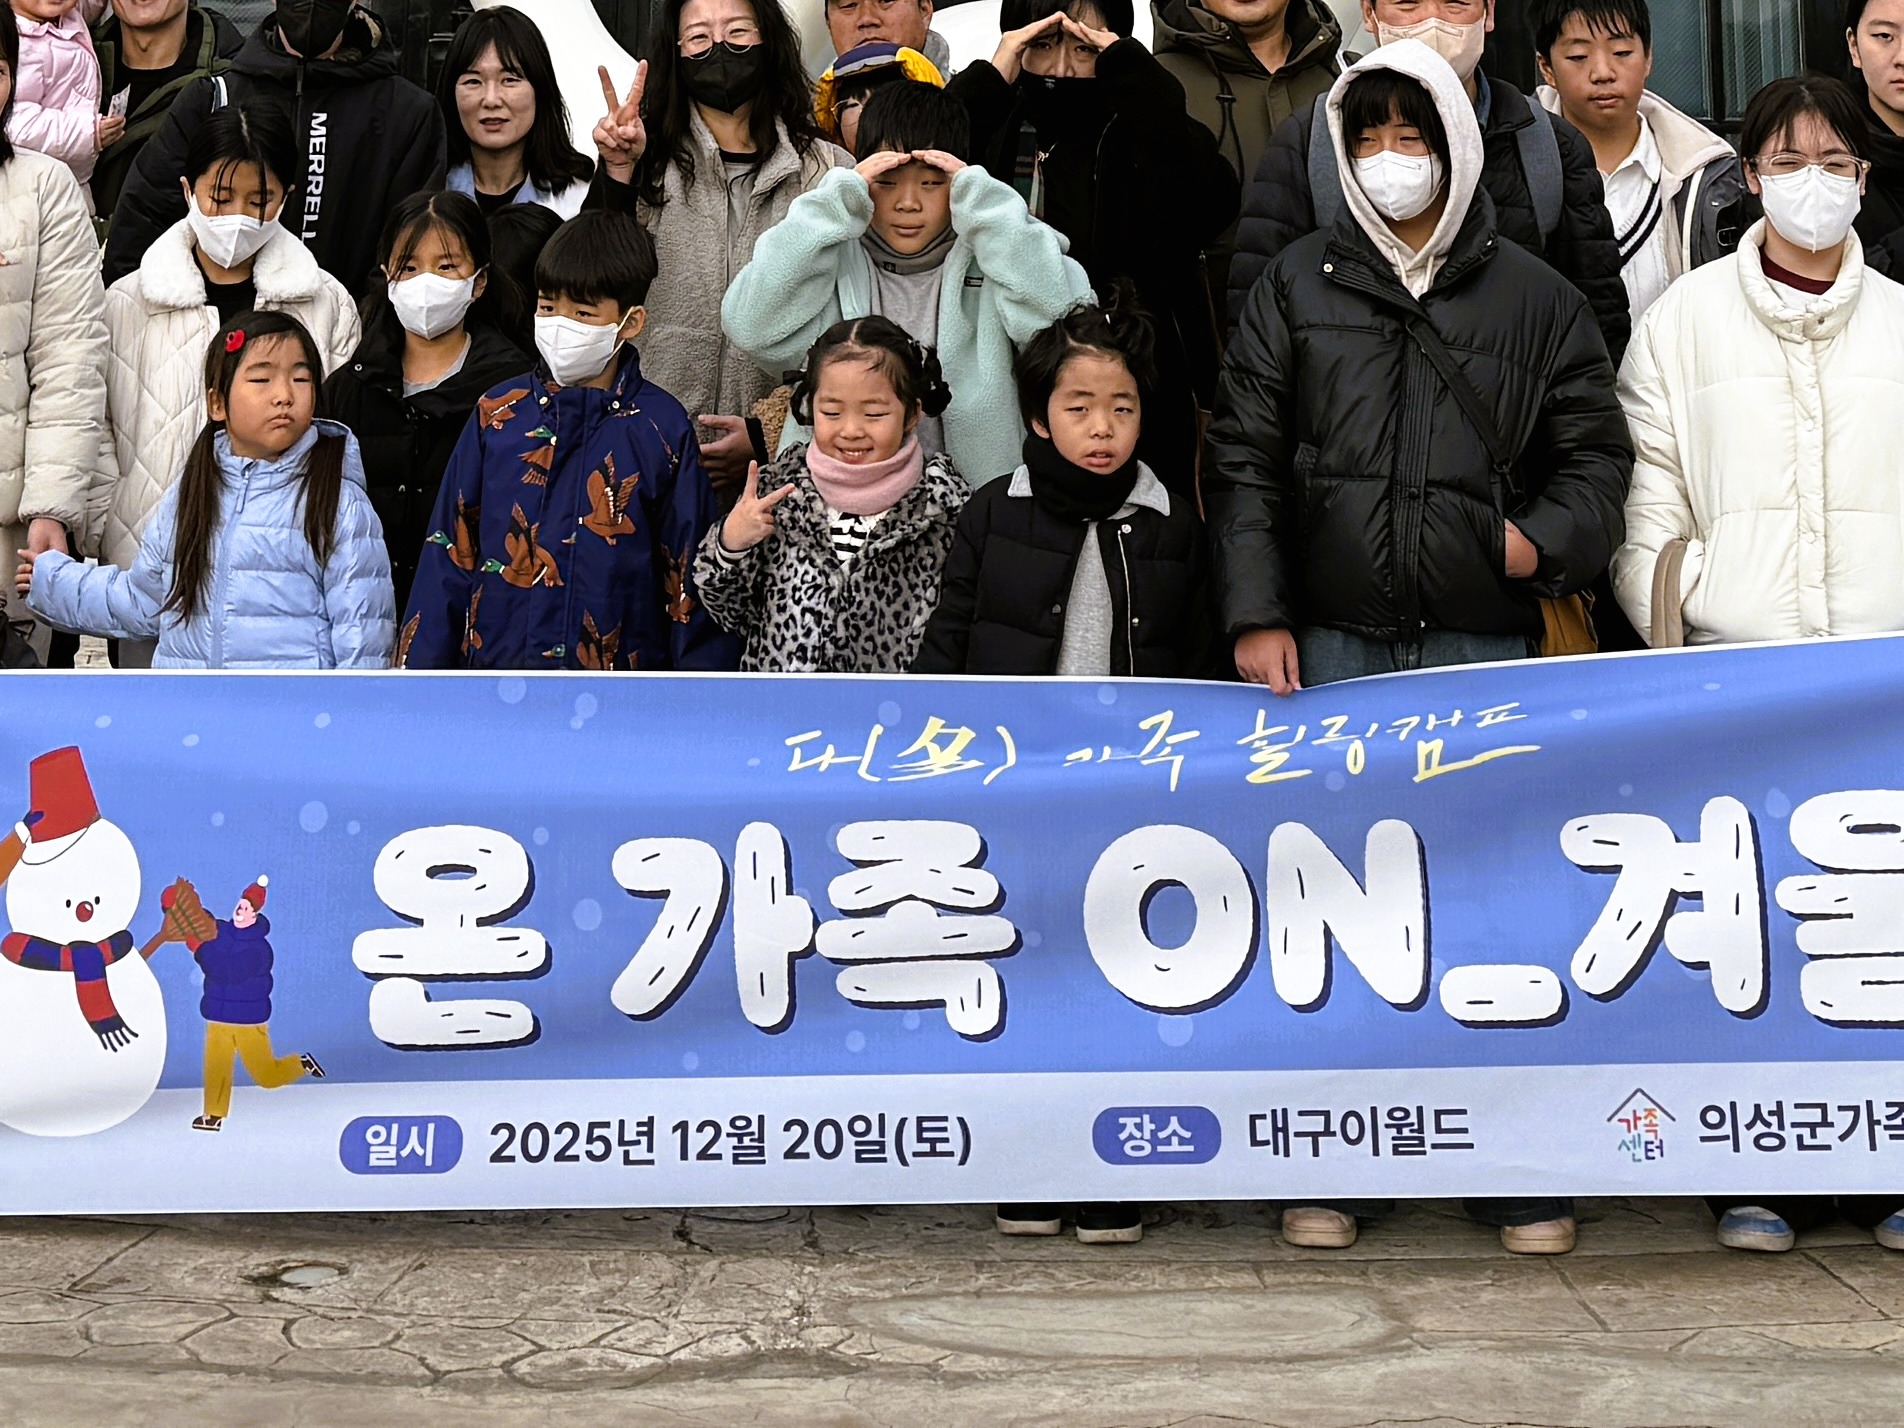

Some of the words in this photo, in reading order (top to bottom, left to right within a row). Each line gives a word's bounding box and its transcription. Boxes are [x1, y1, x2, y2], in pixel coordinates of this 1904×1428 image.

[301, 112, 328, 242] MERRELL
[1236, 702, 1542, 784] 힐링캠프
[351, 824, 548, 1046] 온
[610, 820, 1017, 1037] 가족
[364, 1123, 435, 1167] 일시
[488, 1115, 655, 1166] 2025년
[671, 1114, 767, 1165] 12월
[782, 1112, 971, 1168] 20일(토)
[1117, 1114, 1195, 1154] 장소
[1248, 1105, 1475, 1158] 대구이월드
